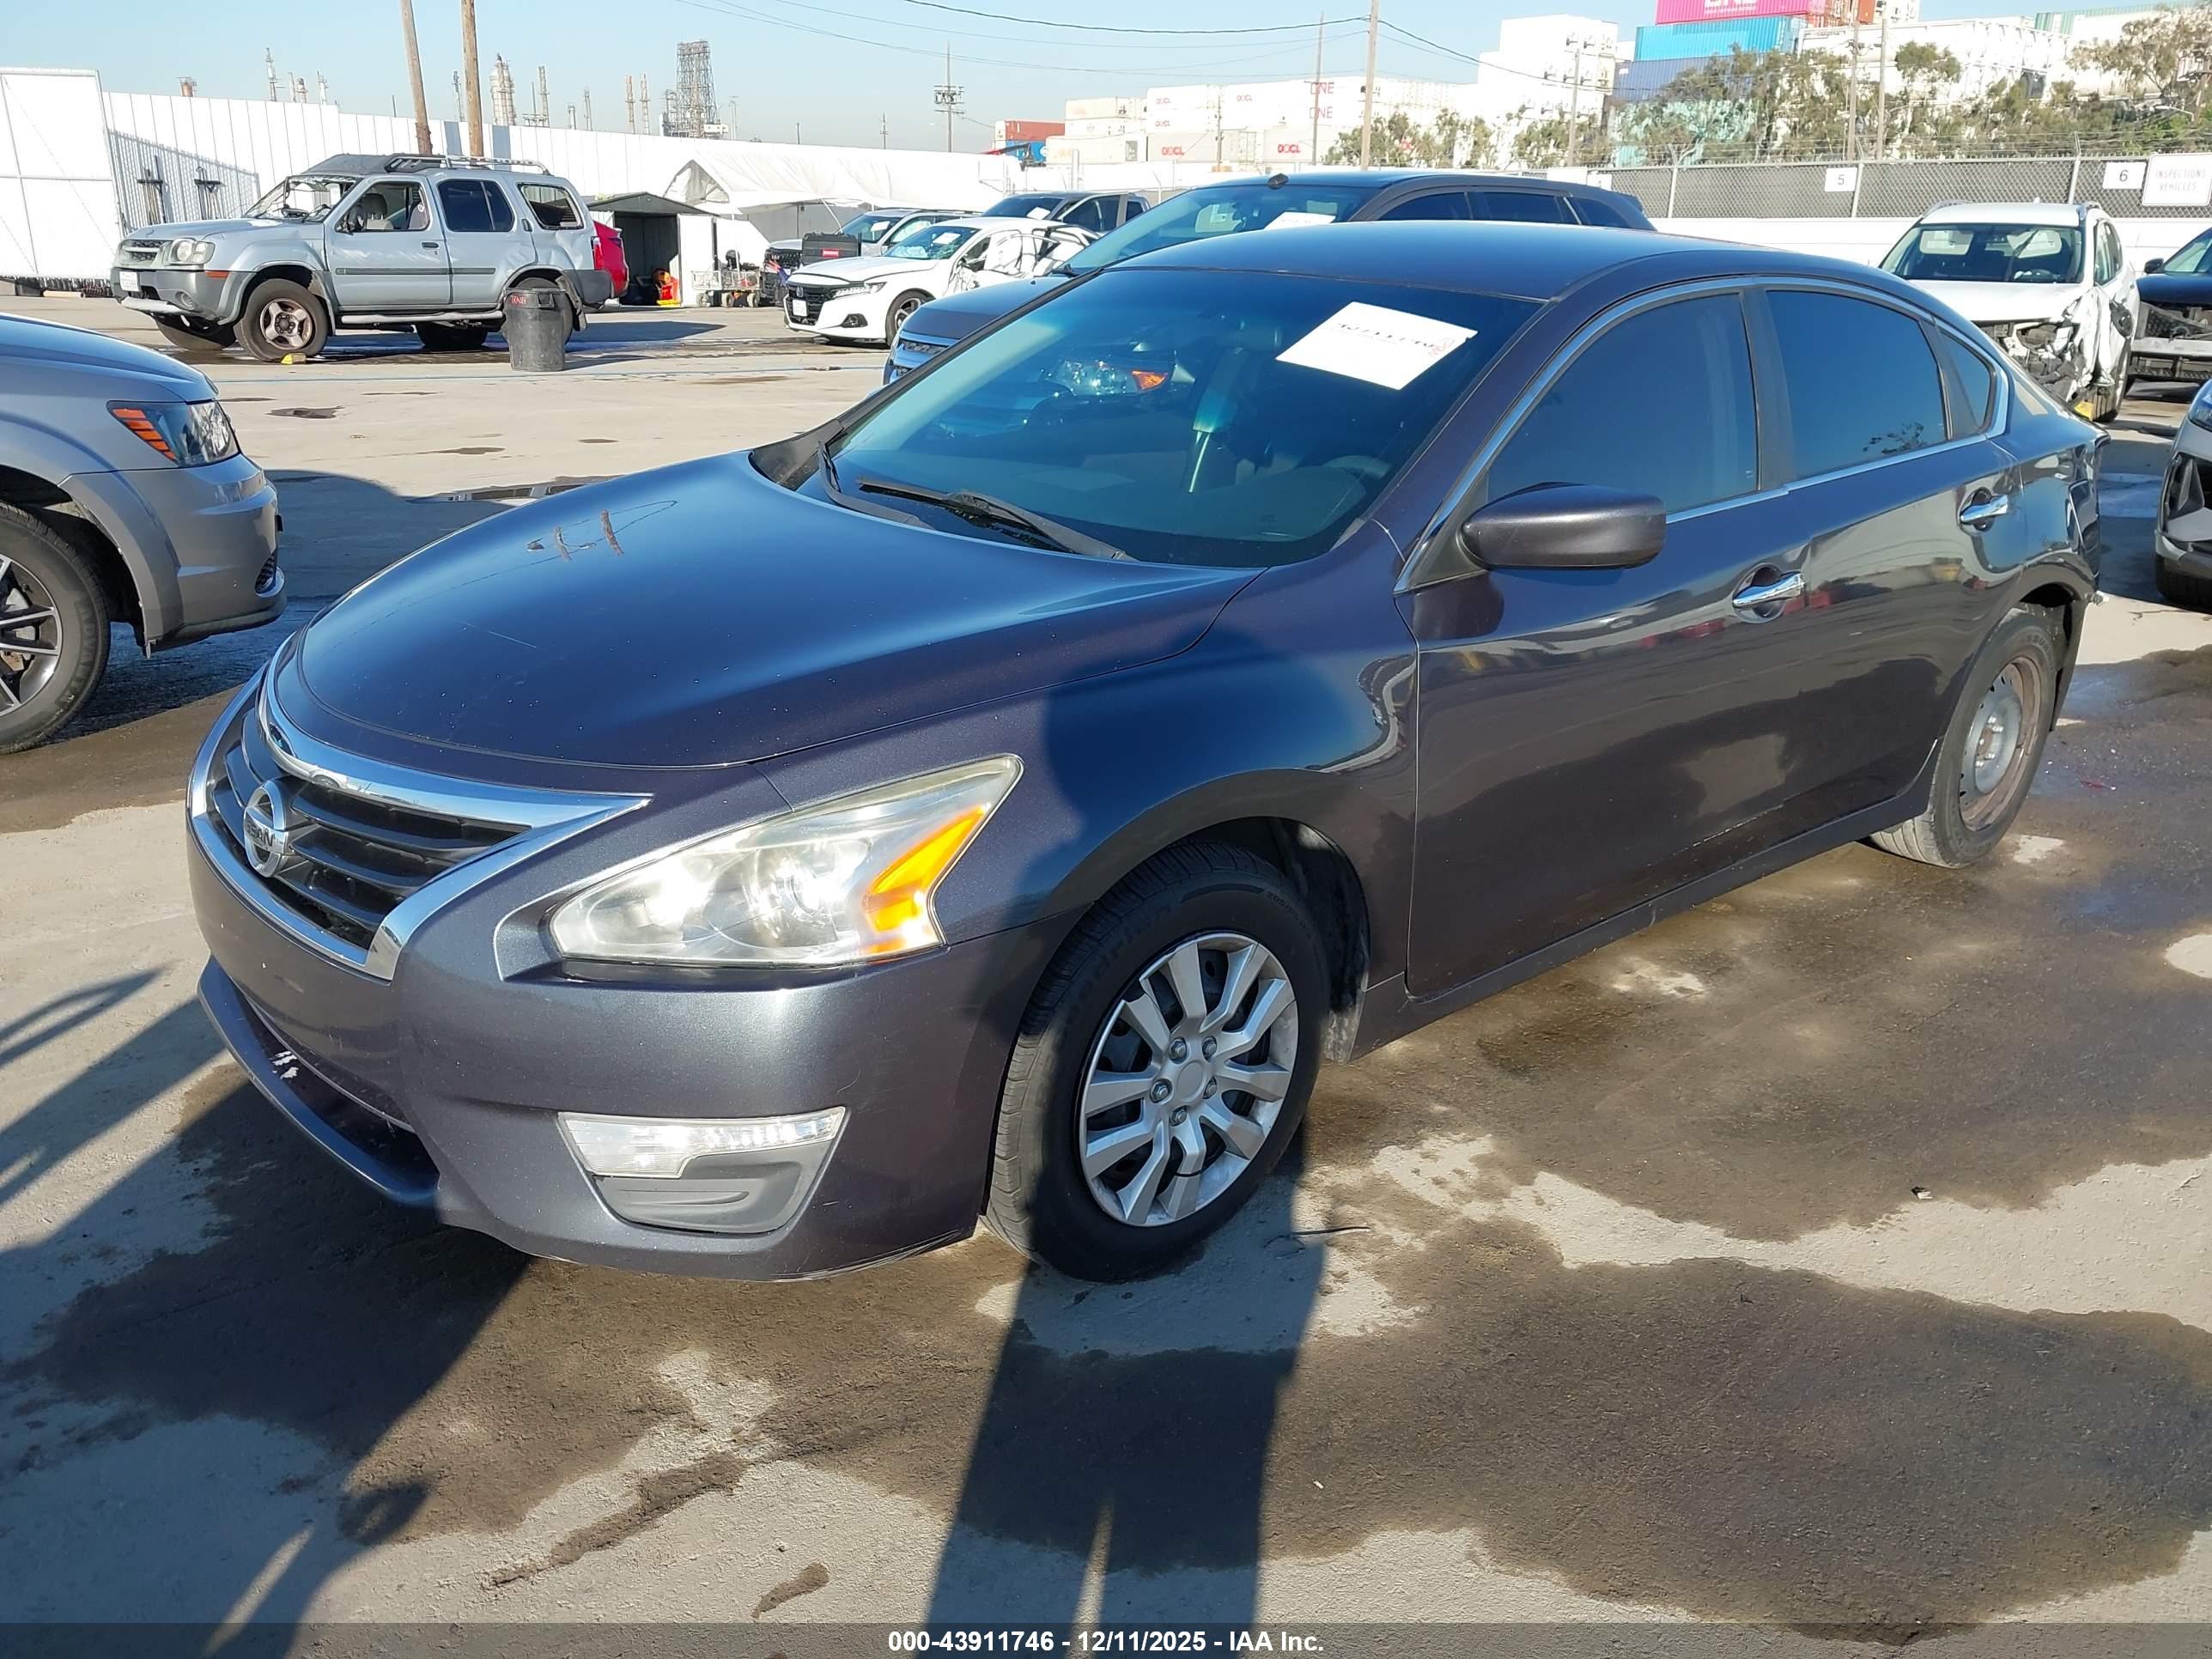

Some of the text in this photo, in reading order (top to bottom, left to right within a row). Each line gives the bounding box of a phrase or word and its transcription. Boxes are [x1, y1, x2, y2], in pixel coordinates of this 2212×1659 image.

[1837, 173, 1845, 185] 5
[2118, 169, 2130, 182] 6
[2154, 168, 2206, 179] INSPECTIONS
[2159, 181, 2198, 191] VEHICLES
